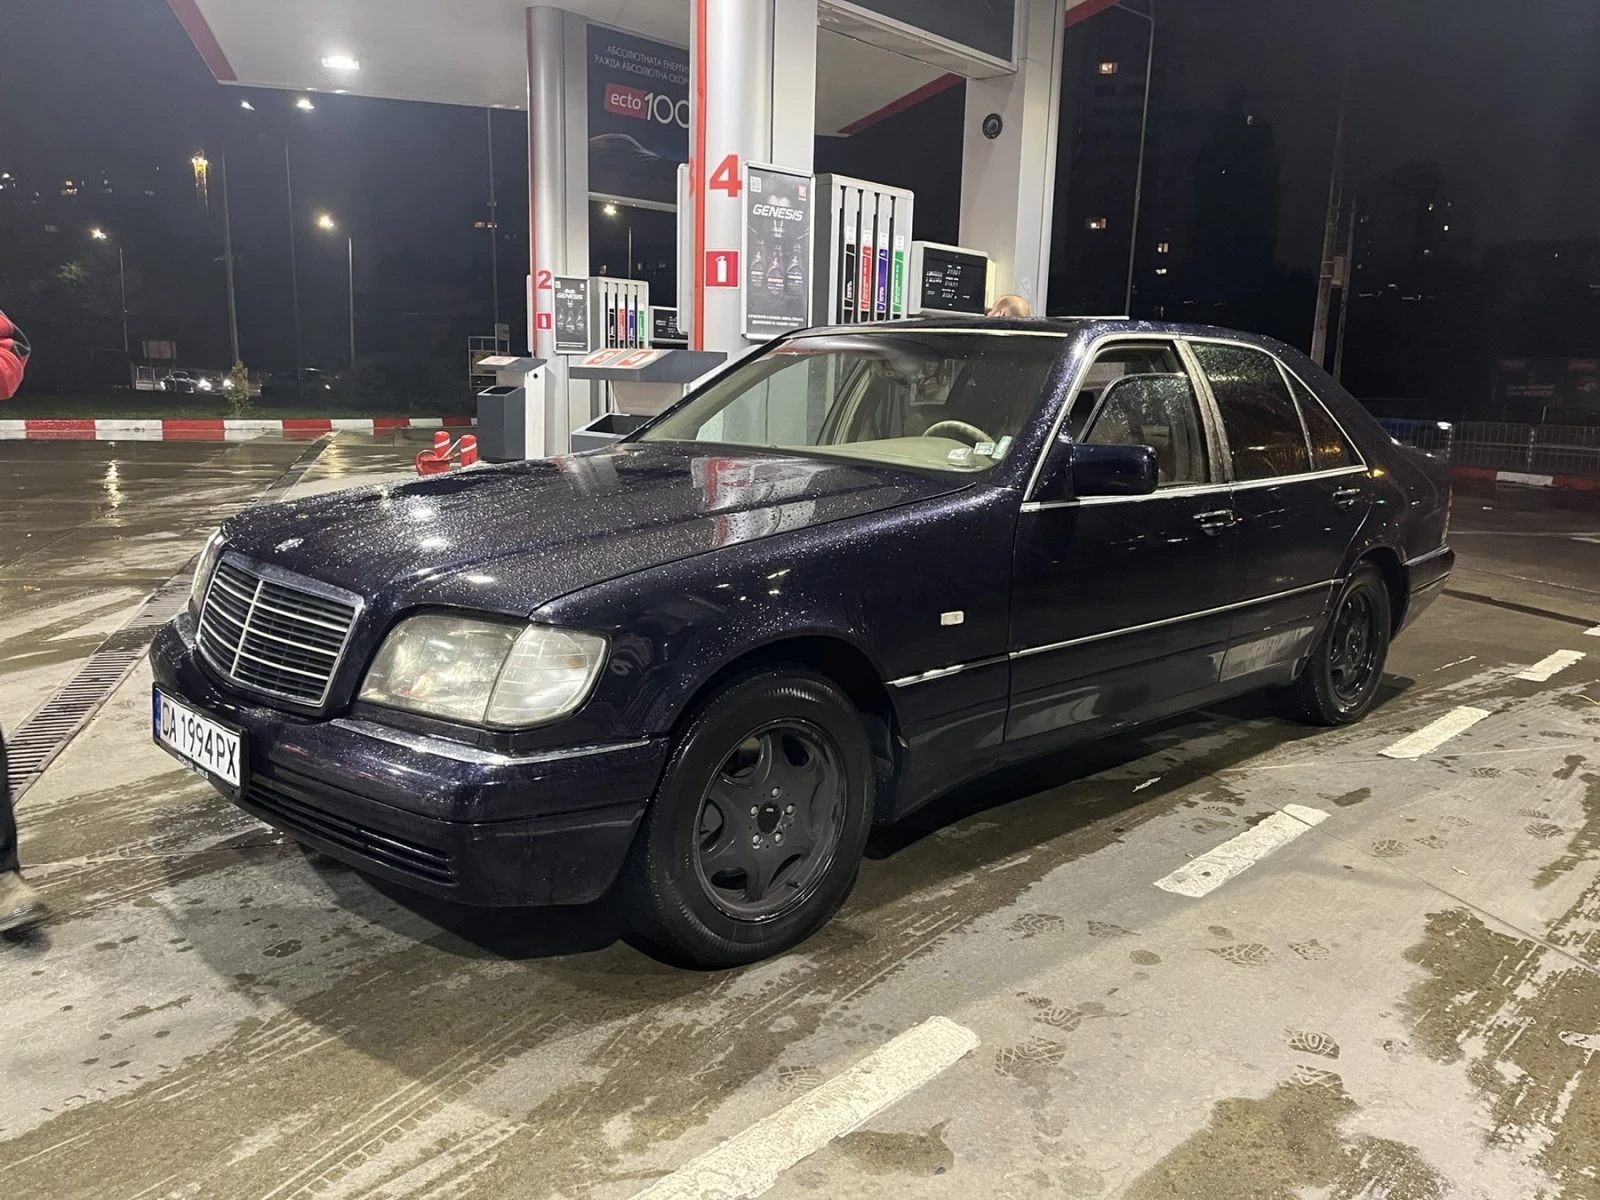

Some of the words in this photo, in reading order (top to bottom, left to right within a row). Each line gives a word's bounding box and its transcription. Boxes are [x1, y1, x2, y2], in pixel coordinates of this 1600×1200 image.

[607, 45, 662, 67] АБСОЛЮТНАТА
[594, 54, 621, 69] РАЖДА
[622, 61, 669, 80] АБСОЛЮТНА
[709, 154, 742, 197] 4
[753, 204, 804, 221] GENESIS
[538, 269, 552, 290] 2
[556, 292, 584, 300] GENESIS
